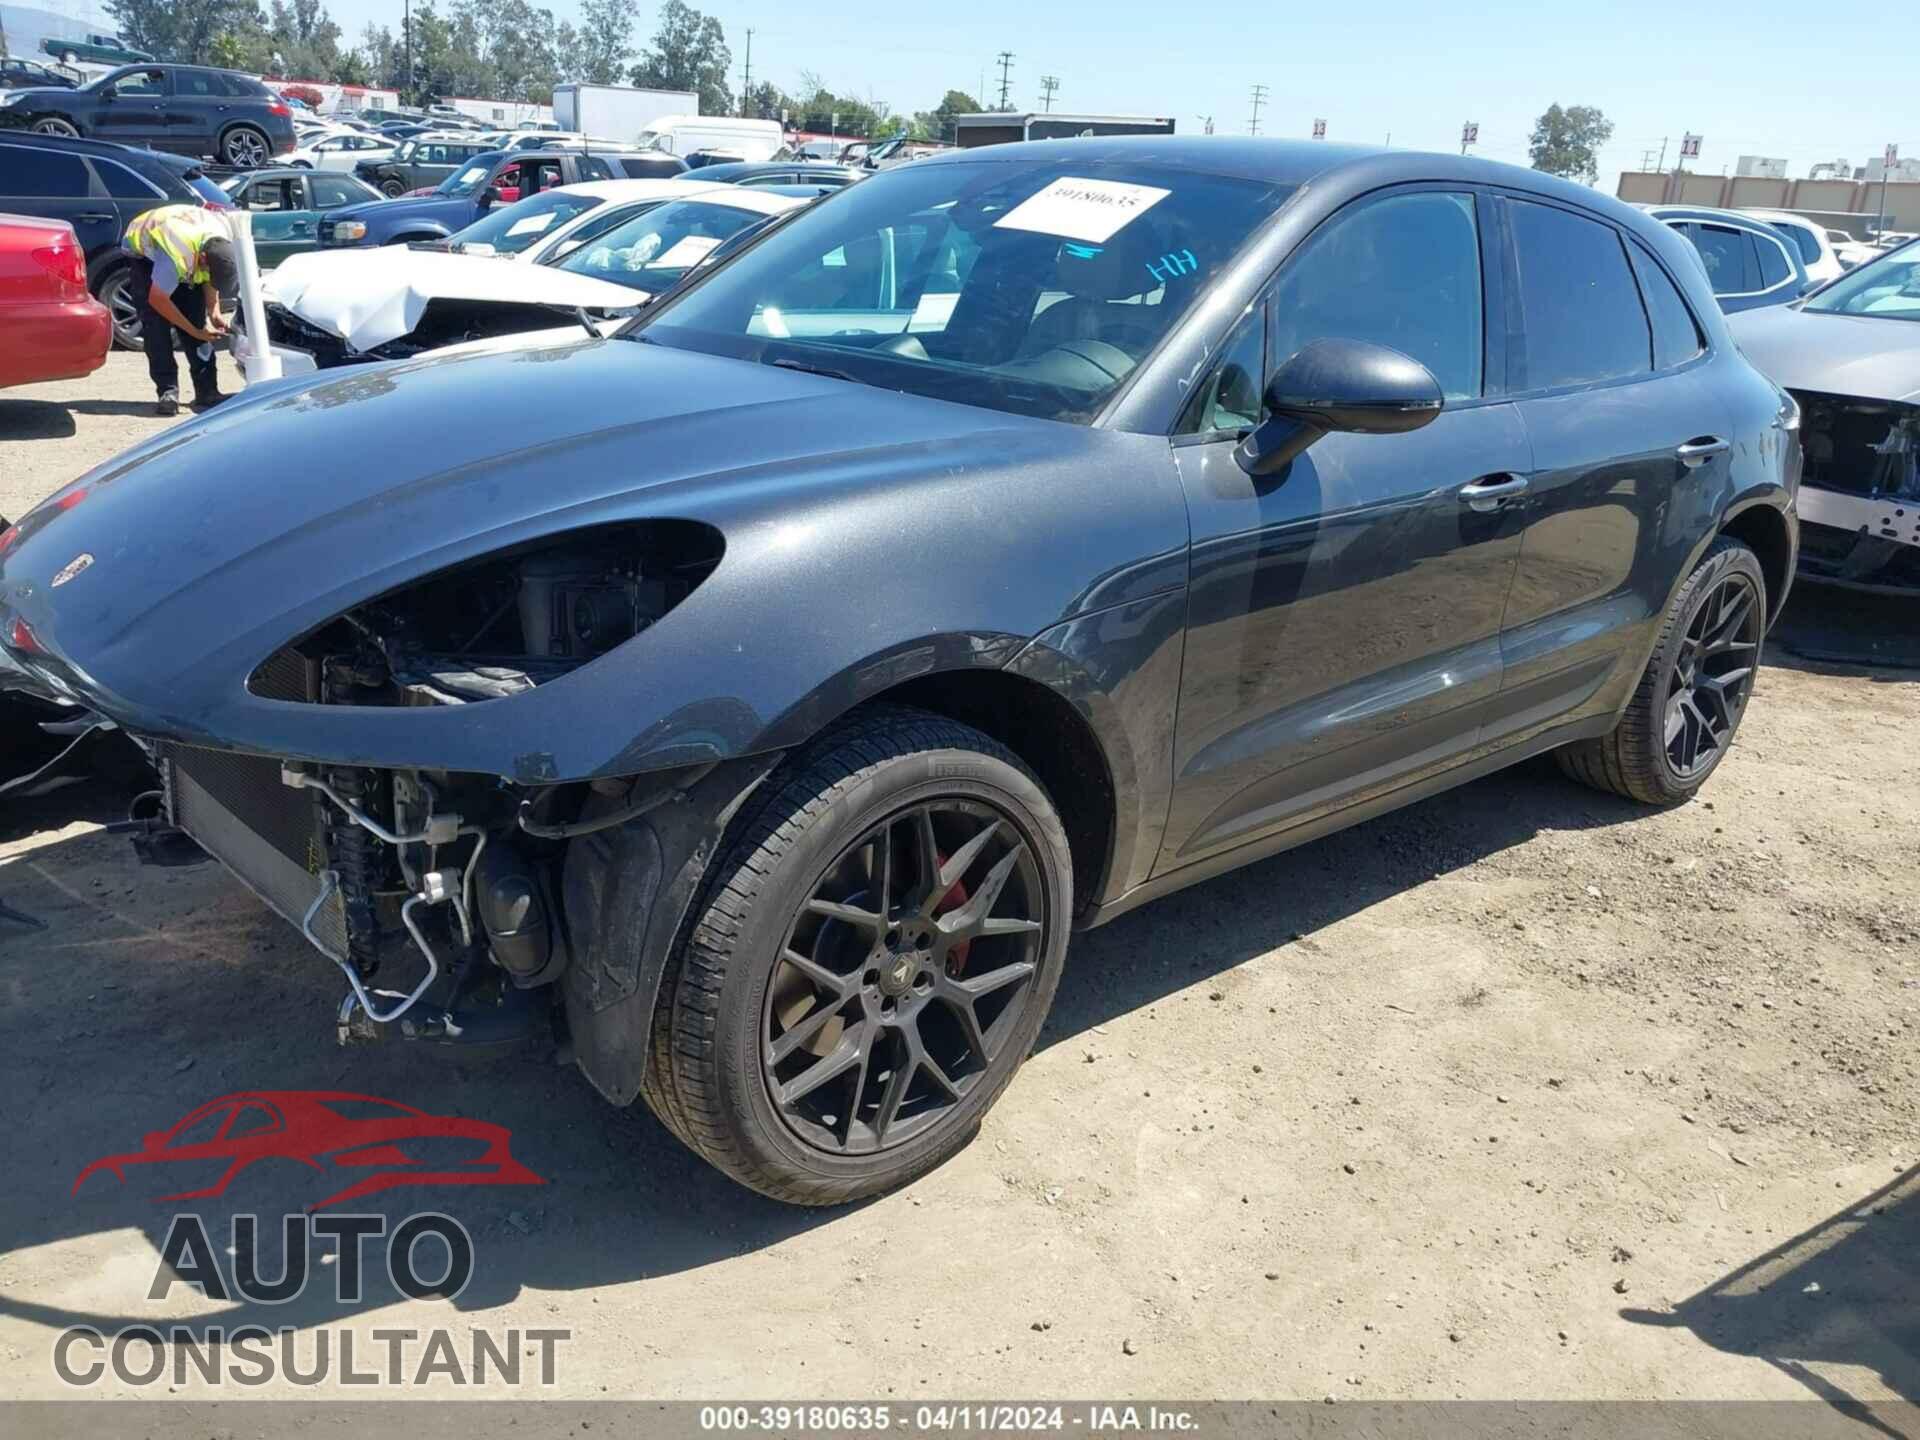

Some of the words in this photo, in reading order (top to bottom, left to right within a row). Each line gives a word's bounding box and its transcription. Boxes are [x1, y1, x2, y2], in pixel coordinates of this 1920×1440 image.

[1313, 121, 1326, 137] 13
[1462, 127, 1478, 141] 12
[1681, 140, 1699, 156] 11
